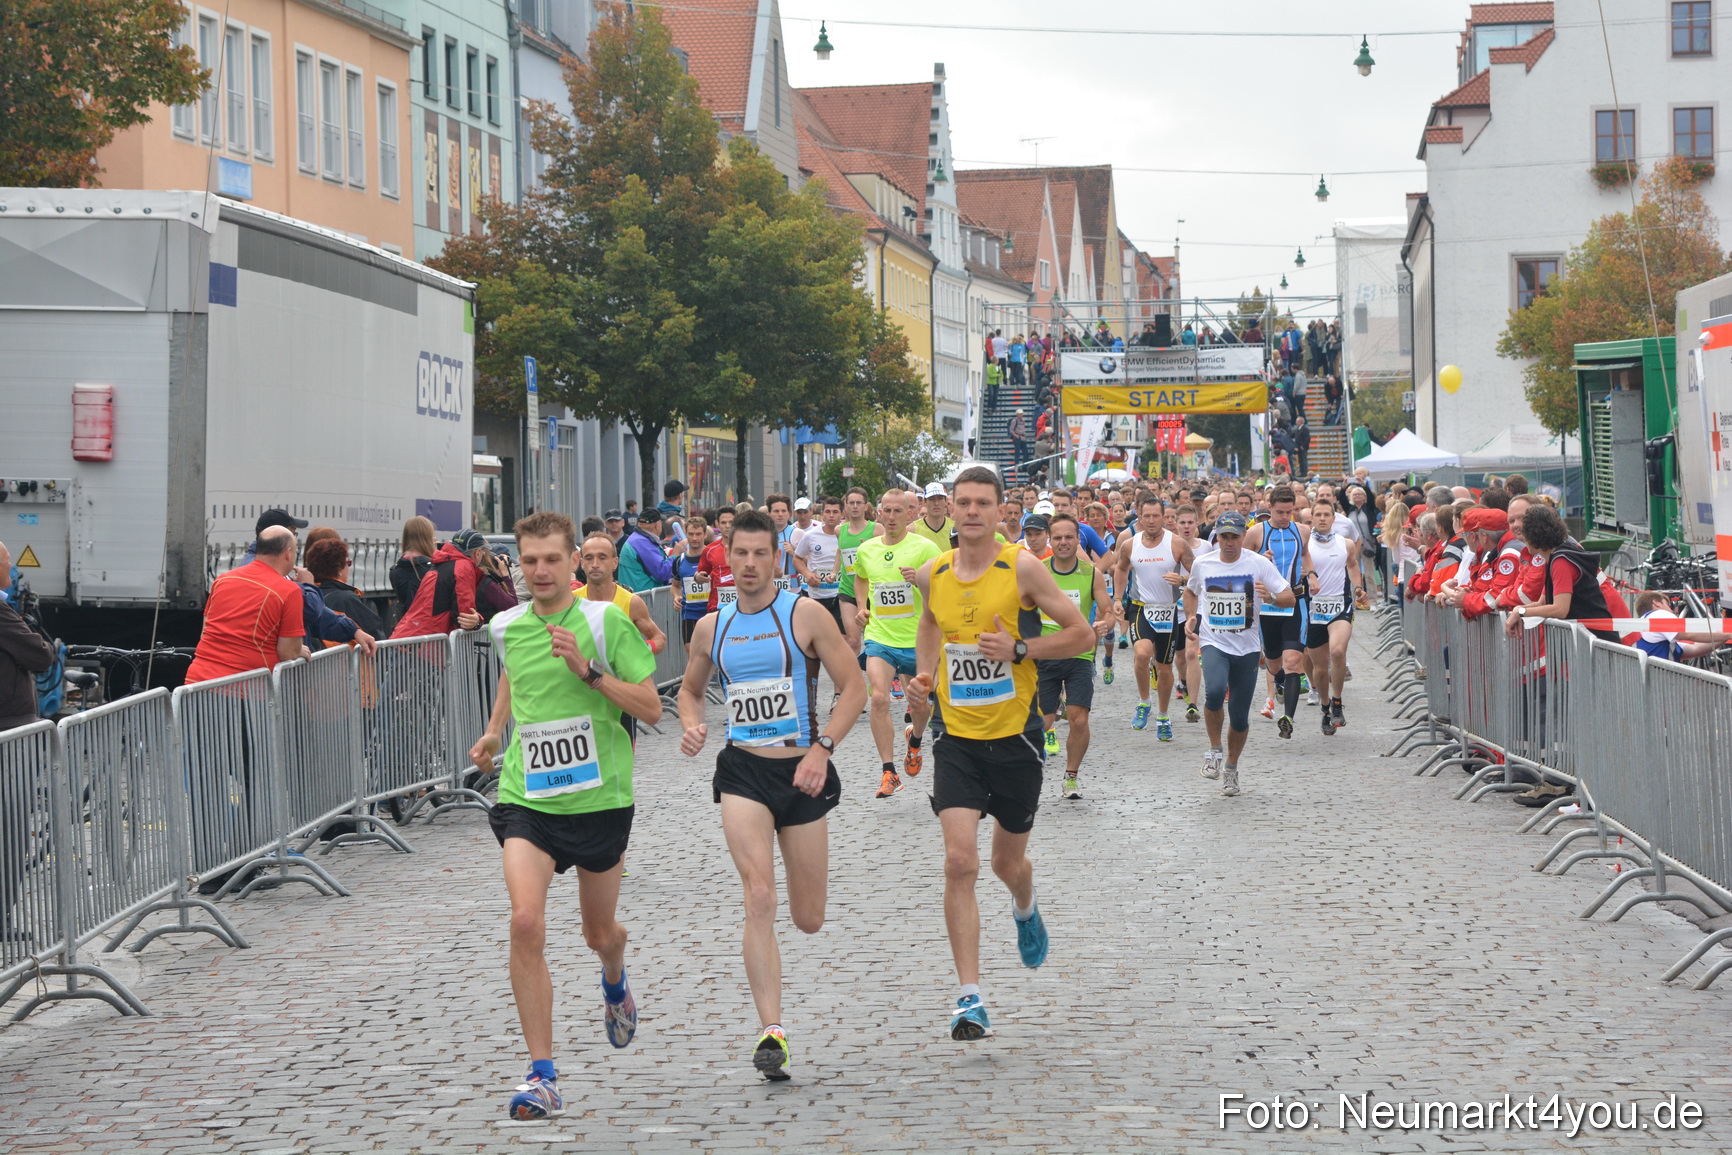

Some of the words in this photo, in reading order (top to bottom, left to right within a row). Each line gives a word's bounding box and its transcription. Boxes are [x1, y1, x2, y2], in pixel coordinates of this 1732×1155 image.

[1121, 358, 1144, 366] BMW
[417, 352, 463, 421] BOCK
[1129, 390, 1200, 407] START
[692, 583, 703, 593] 69
[880, 590, 906, 605] 635
[1148, 610, 1172, 621] 2232
[1210, 601, 1242, 616] 2013
[1315, 603, 1341, 614] 3376
[951, 658, 1006, 681] 2062
[728, 689, 746, 698] PARTL
[747, 685, 780, 694] Neumarkt
[966, 687, 994, 697] Stefan
[732, 693, 790, 723] 2002
[520, 730, 541, 739] PARTL
[541, 724, 579, 738] Neumarkt
[749, 726, 778, 738] Marco
[528, 734, 589, 770] 2000
[547, 773, 573, 786] Lang
